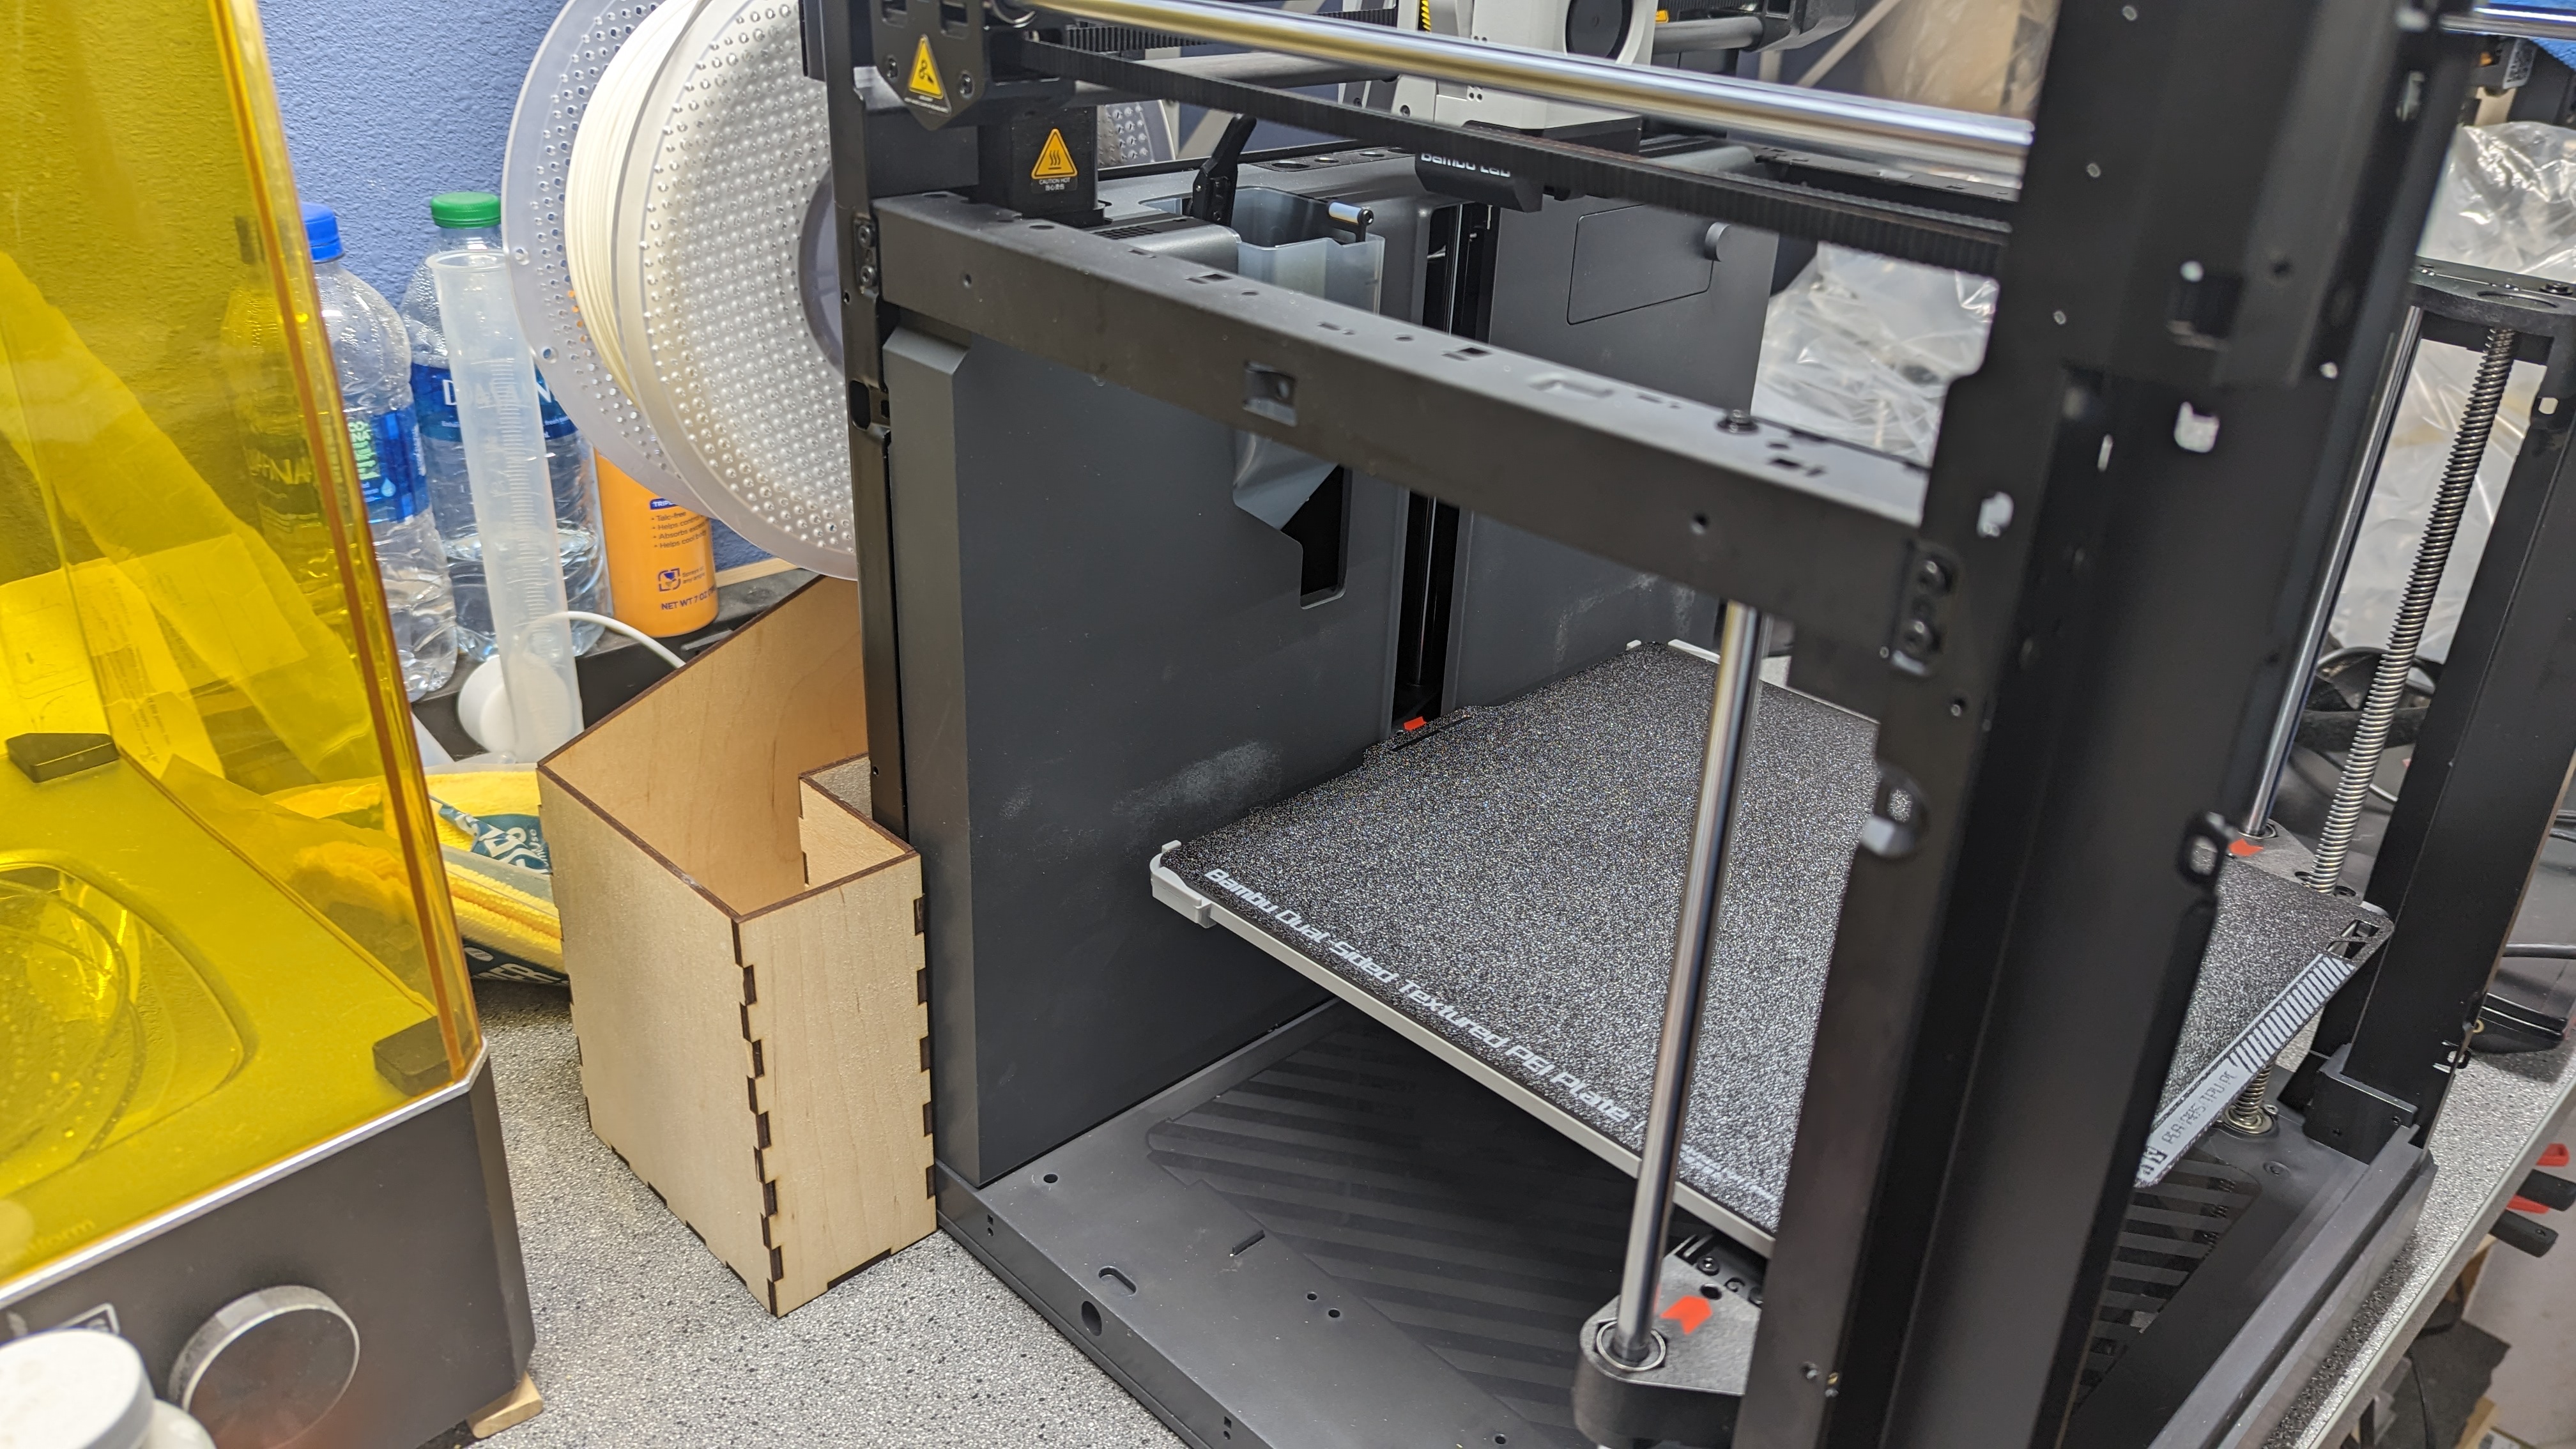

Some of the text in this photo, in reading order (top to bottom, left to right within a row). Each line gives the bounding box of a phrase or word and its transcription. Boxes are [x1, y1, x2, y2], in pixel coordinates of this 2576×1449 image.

[661, 601, 678, 610] NET
[679, 597, 694, 607] WT
[1204, 868, 1279, 913] Bambu
[1399, 979, 1512, 1049] Textured
[1505, 1045, 1556, 1076] PEI
[1549, 1071, 1631, 1123] Plate
